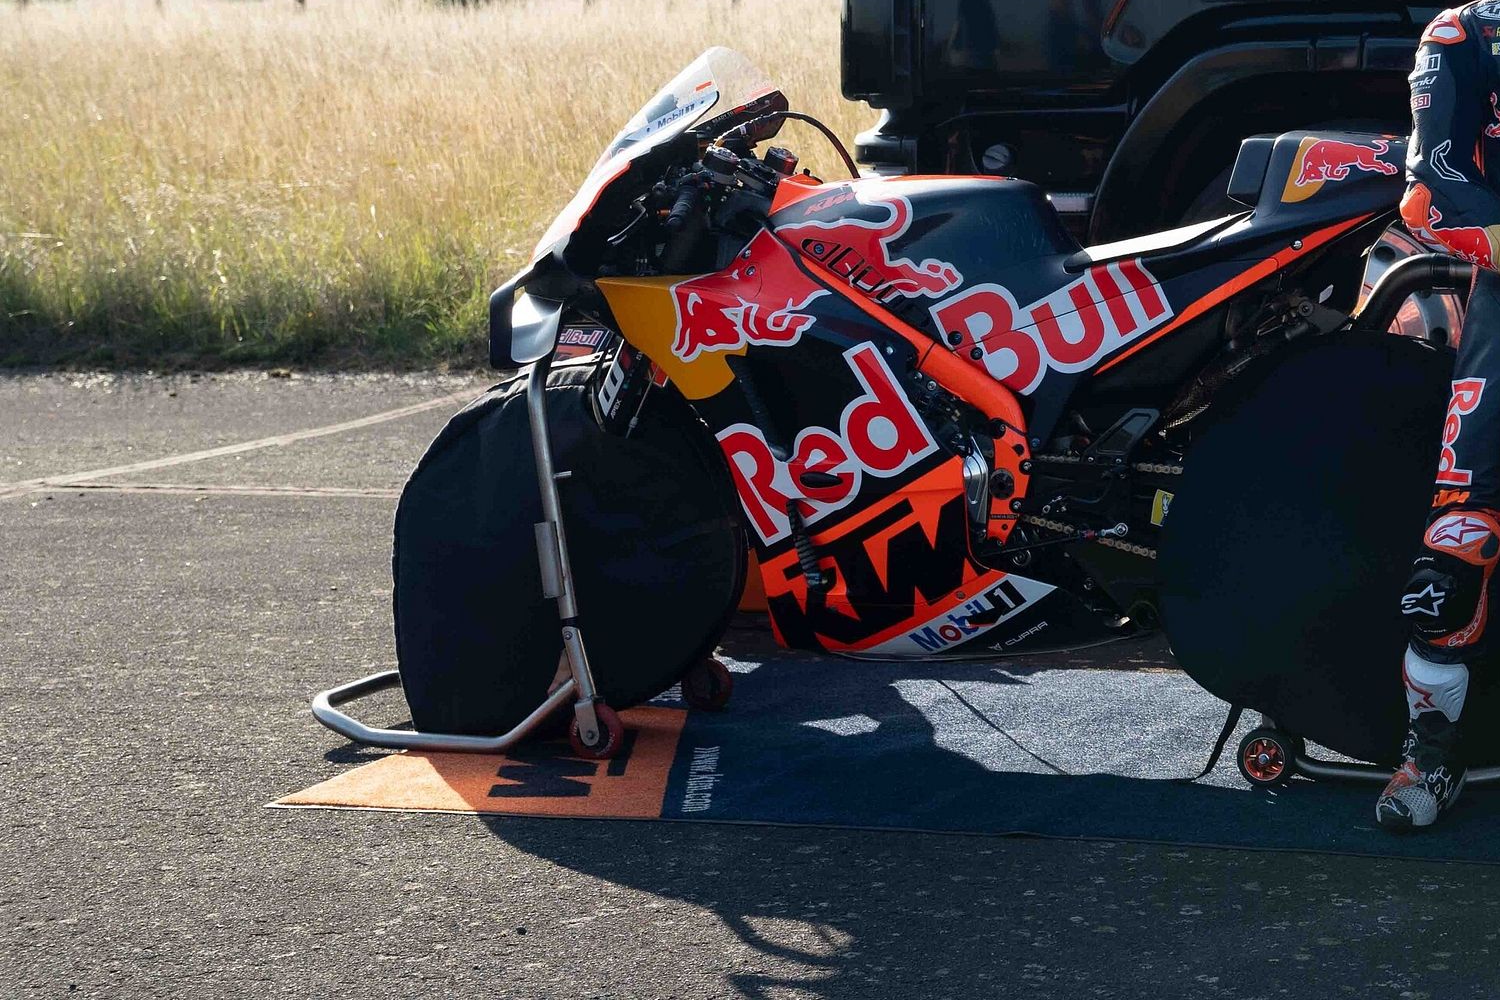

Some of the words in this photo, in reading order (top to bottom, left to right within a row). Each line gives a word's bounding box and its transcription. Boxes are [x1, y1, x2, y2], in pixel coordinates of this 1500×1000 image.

[1410, 75, 1438, 89] ankl
[657, 108, 685, 129] Mobil
[568, 329, 604, 346] Bull
[715, 340, 941, 547] Red
[928, 257, 1174, 396] Bull
[1435, 377, 1487, 487] Red
[768, 490, 990, 650] KTM
[1004, 620, 1049, 646] CUPRA
